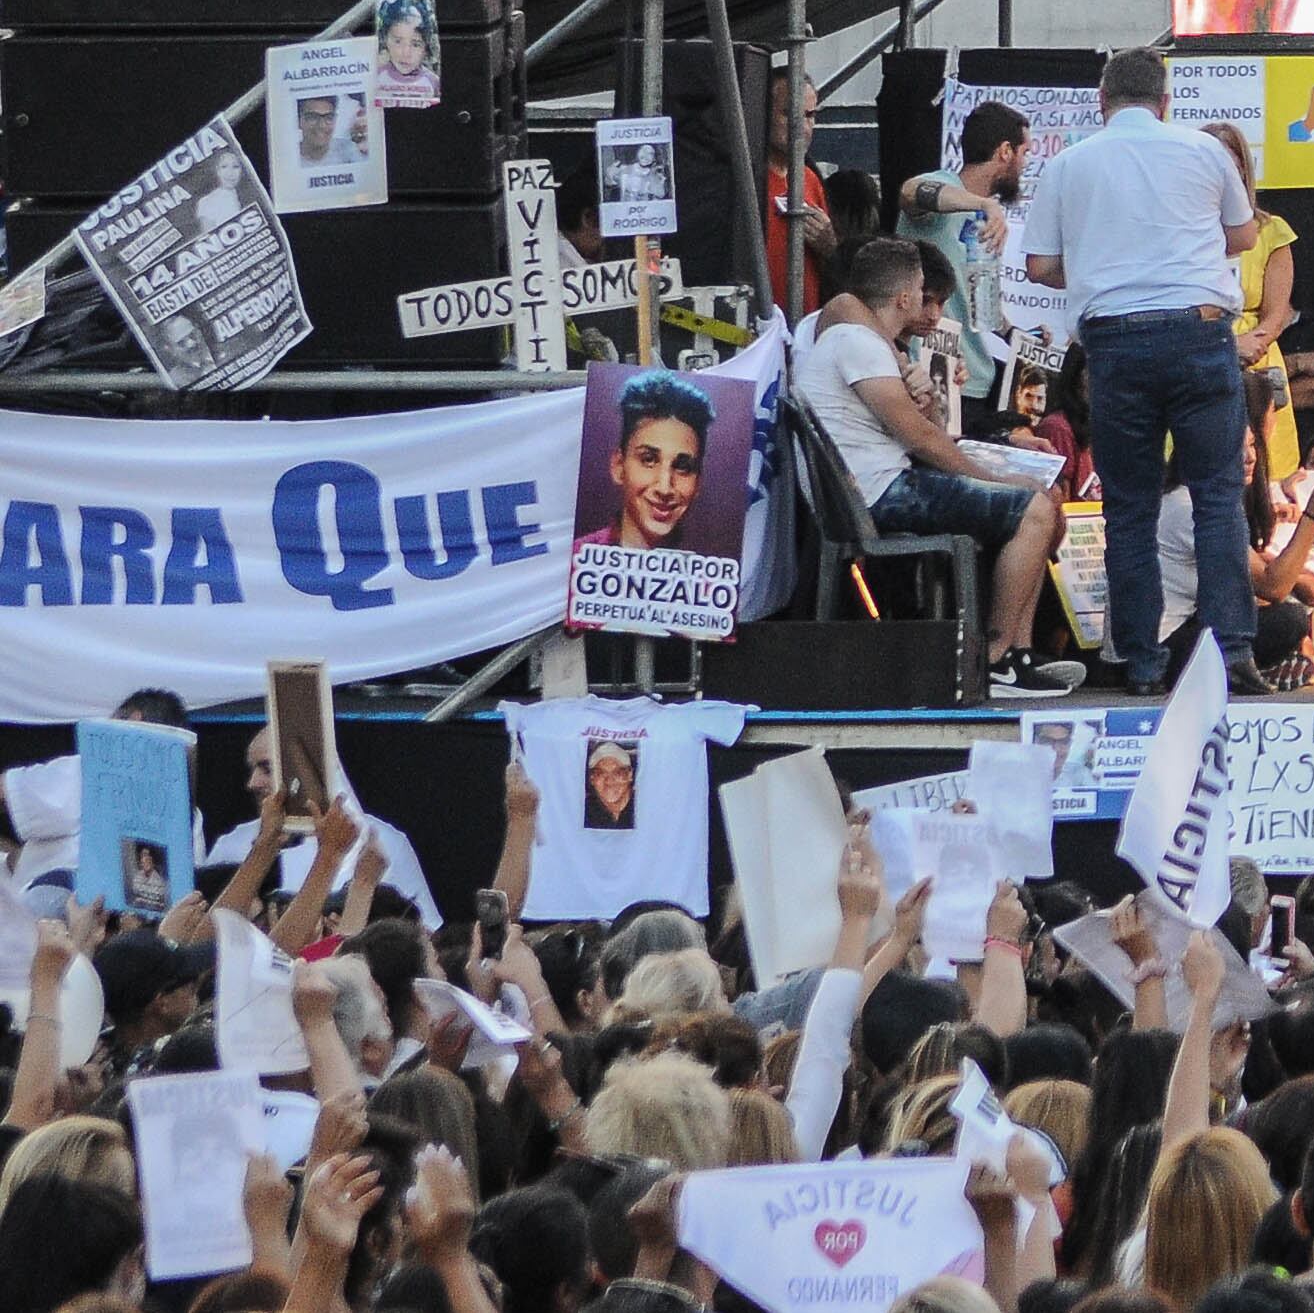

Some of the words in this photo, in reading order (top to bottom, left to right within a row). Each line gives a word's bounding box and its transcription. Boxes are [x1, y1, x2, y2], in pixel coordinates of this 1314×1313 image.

[301, 46, 347, 62] ANGEL
[1173, 65, 1203, 78] POR
[1207, 64, 1257, 77] TODOS
[1173, 87, 1200, 99] LOS
[1173, 107, 1262, 120] FERNANDOS
[611, 126, 662, 141] JUSTICIA
[309, 172, 355, 189] JUSTICIA
[508, 165, 554, 191] PAZ
[92, 184, 191, 252] PAULINA
[628, 205, 647, 217] por
[613, 216, 668, 229] RODRIGO
[516, 198, 550, 372] VICTI
[145, 283, 193, 321] BASTA
[405, 280, 514, 328] TODOS
[0, 501, 244, 607] ARA
[577, 548, 683, 575] JUSTICIA
[690, 559, 735, 581] POR
[576, 570, 732, 610] GONZALO
[575, 601, 646, 622] PERPETUA
[650, 612, 669, 624] AL
[671, 611, 730, 631] ASESINO
[1097, 738, 1143, 750] ANGEL
